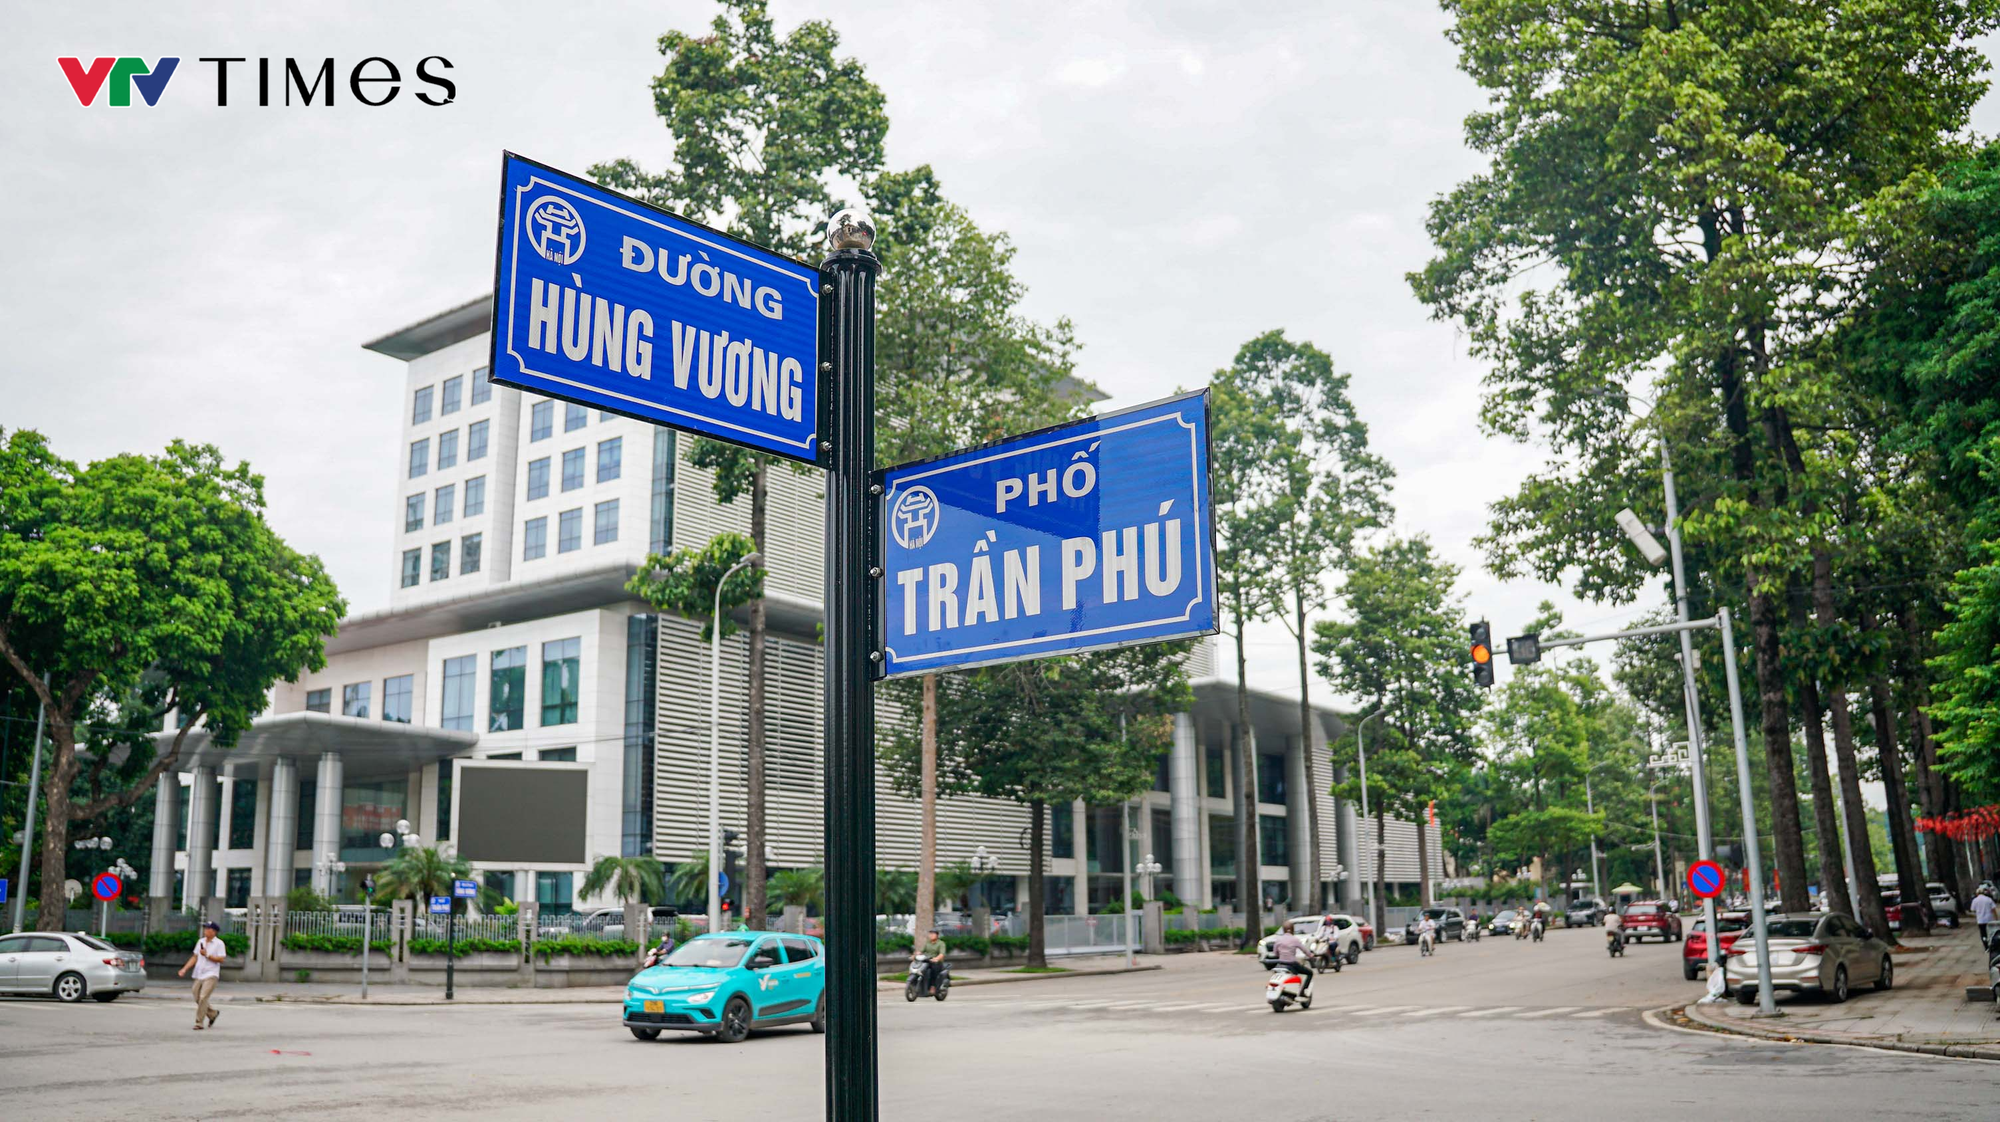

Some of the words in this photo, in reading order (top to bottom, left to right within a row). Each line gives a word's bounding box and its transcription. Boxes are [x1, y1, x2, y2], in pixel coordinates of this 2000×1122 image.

[619, 235, 783, 321] ĐƯỜNG
[528, 272, 654, 381] HÙNG
[671, 320, 803, 423] VƯƠNG
[996, 440, 1101, 514] PHỐ
[897, 529, 1041, 636] TRẦN
[1061, 498, 1182, 611] PHÚ
